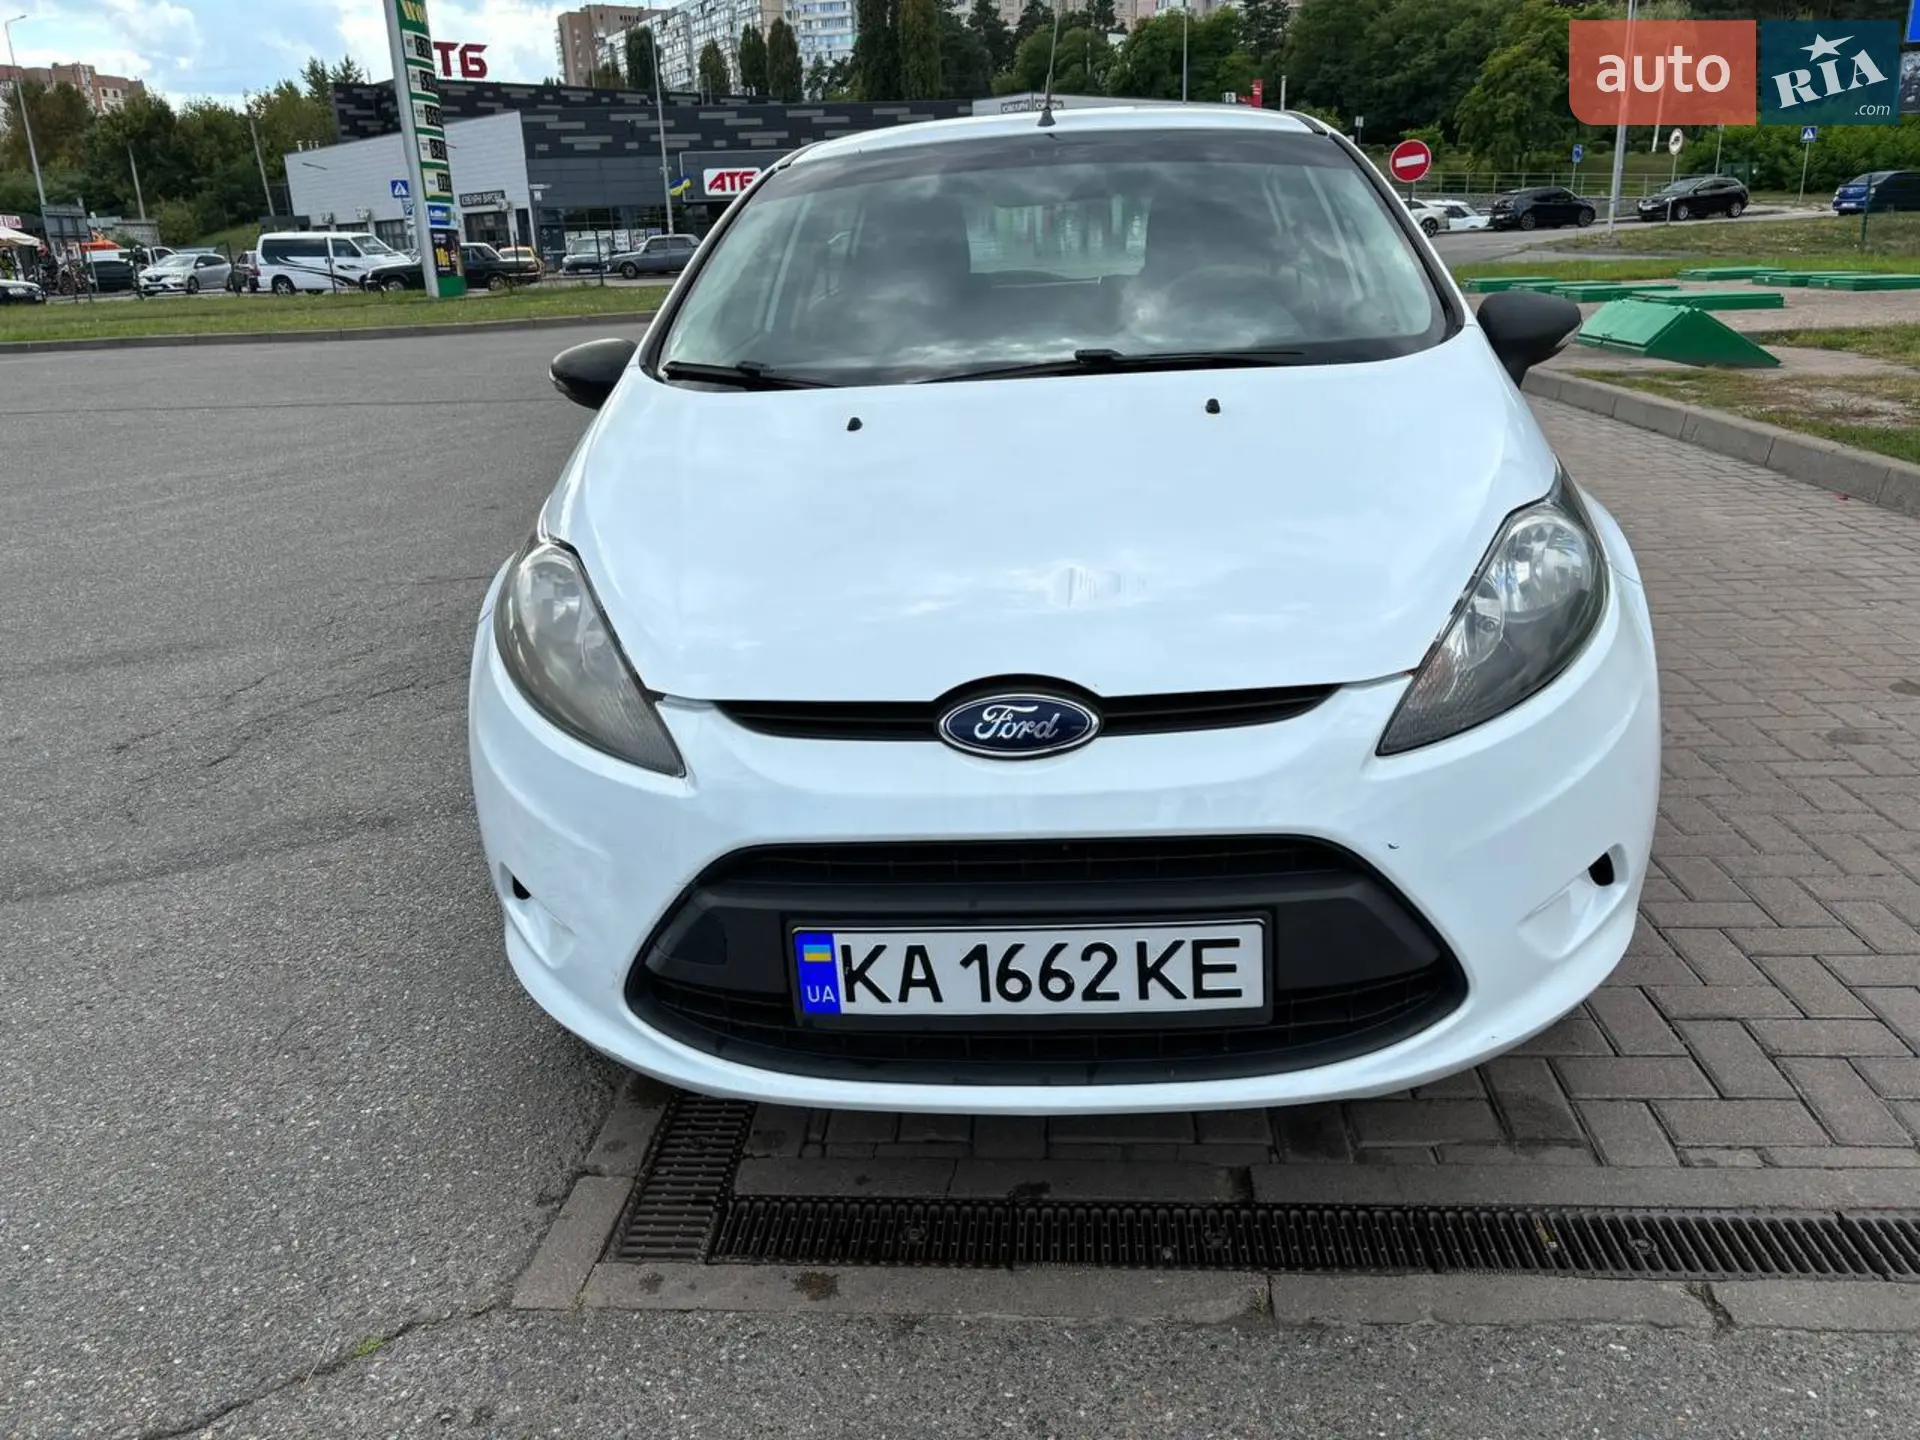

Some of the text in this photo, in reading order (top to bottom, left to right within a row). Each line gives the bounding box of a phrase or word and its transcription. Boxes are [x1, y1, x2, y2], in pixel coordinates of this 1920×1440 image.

[433, 41, 488, 79] ТБ
[973, 704, 1060, 740] Ford
[841, 938, 1243, 1004] KA 1662 KE
[806, 984, 836, 1003] UA
